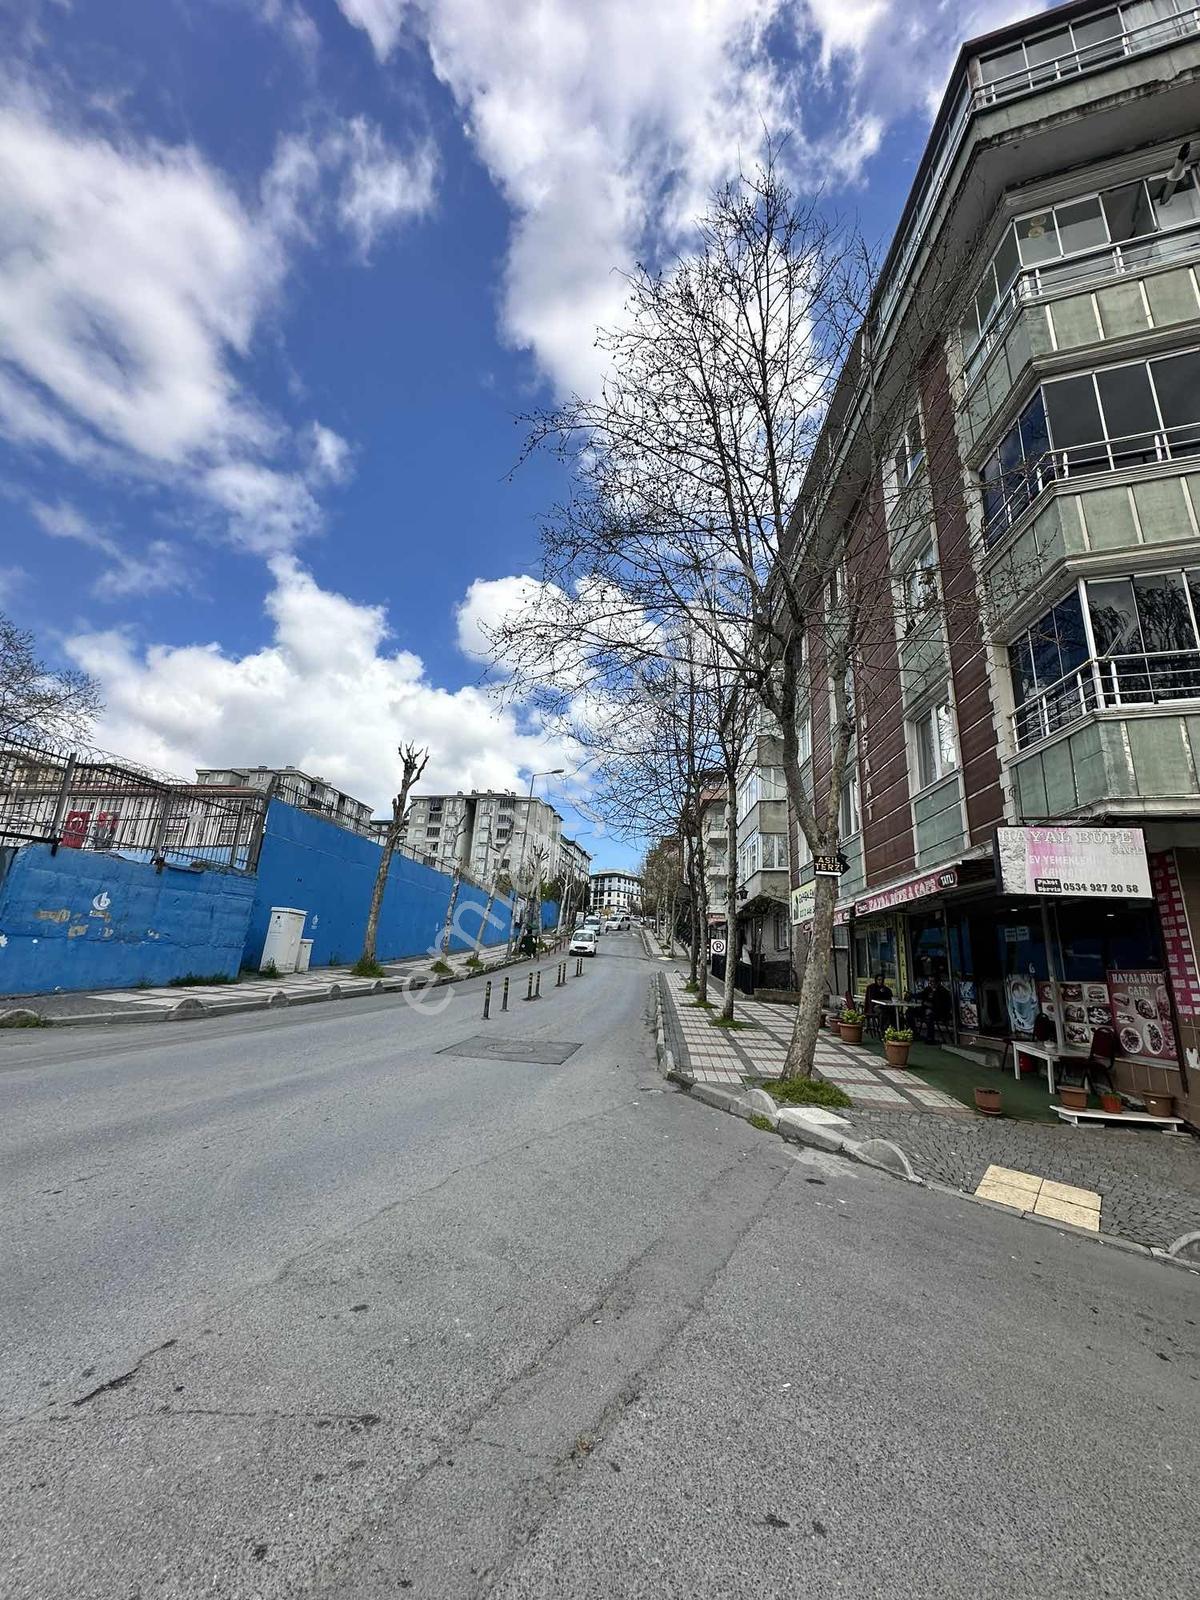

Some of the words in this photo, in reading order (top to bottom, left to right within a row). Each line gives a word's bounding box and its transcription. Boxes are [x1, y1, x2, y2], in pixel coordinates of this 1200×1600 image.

[1000, 829, 1070, 844] HAYAL
[1076, 828, 1132, 844] BÜFE
[1029, 856, 1041, 865] EV
[1063, 882, 1087, 892] 0534
[1090, 883, 1108, 893] 927
[1111, 884, 1123, 893] 20
[1126, 884, 1139, 894] 58
